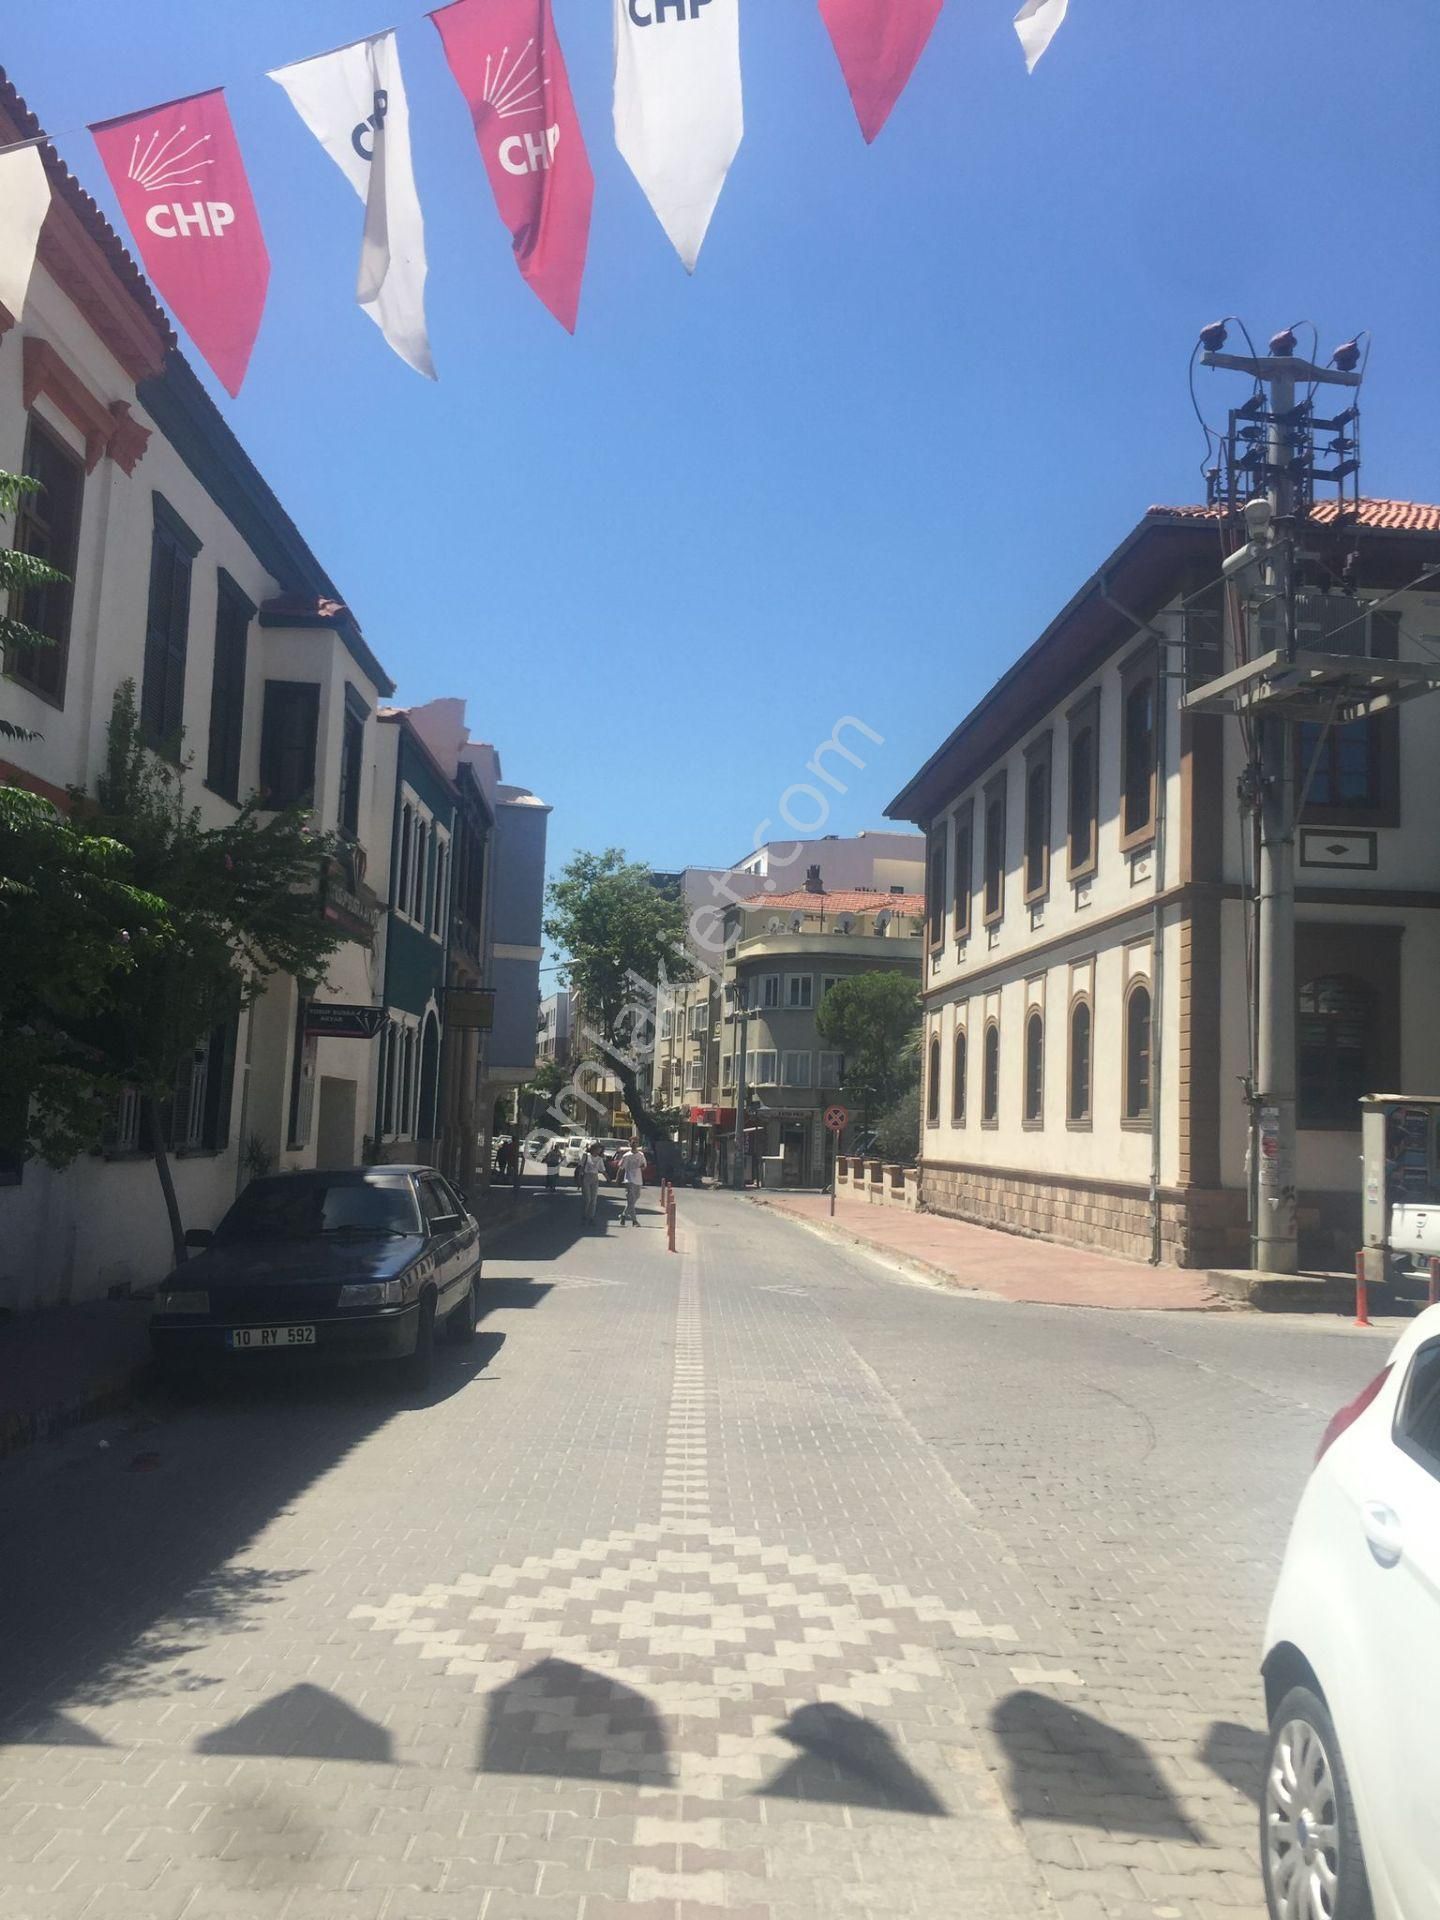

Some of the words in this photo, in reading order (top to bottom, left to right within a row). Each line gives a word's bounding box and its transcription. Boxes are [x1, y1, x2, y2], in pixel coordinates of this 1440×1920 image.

[145, 201, 235, 238] CHP
[235, 1331, 251, 1345] 10
[261, 1329, 278, 1344] RY
[287, 1327, 313, 1342] 592
